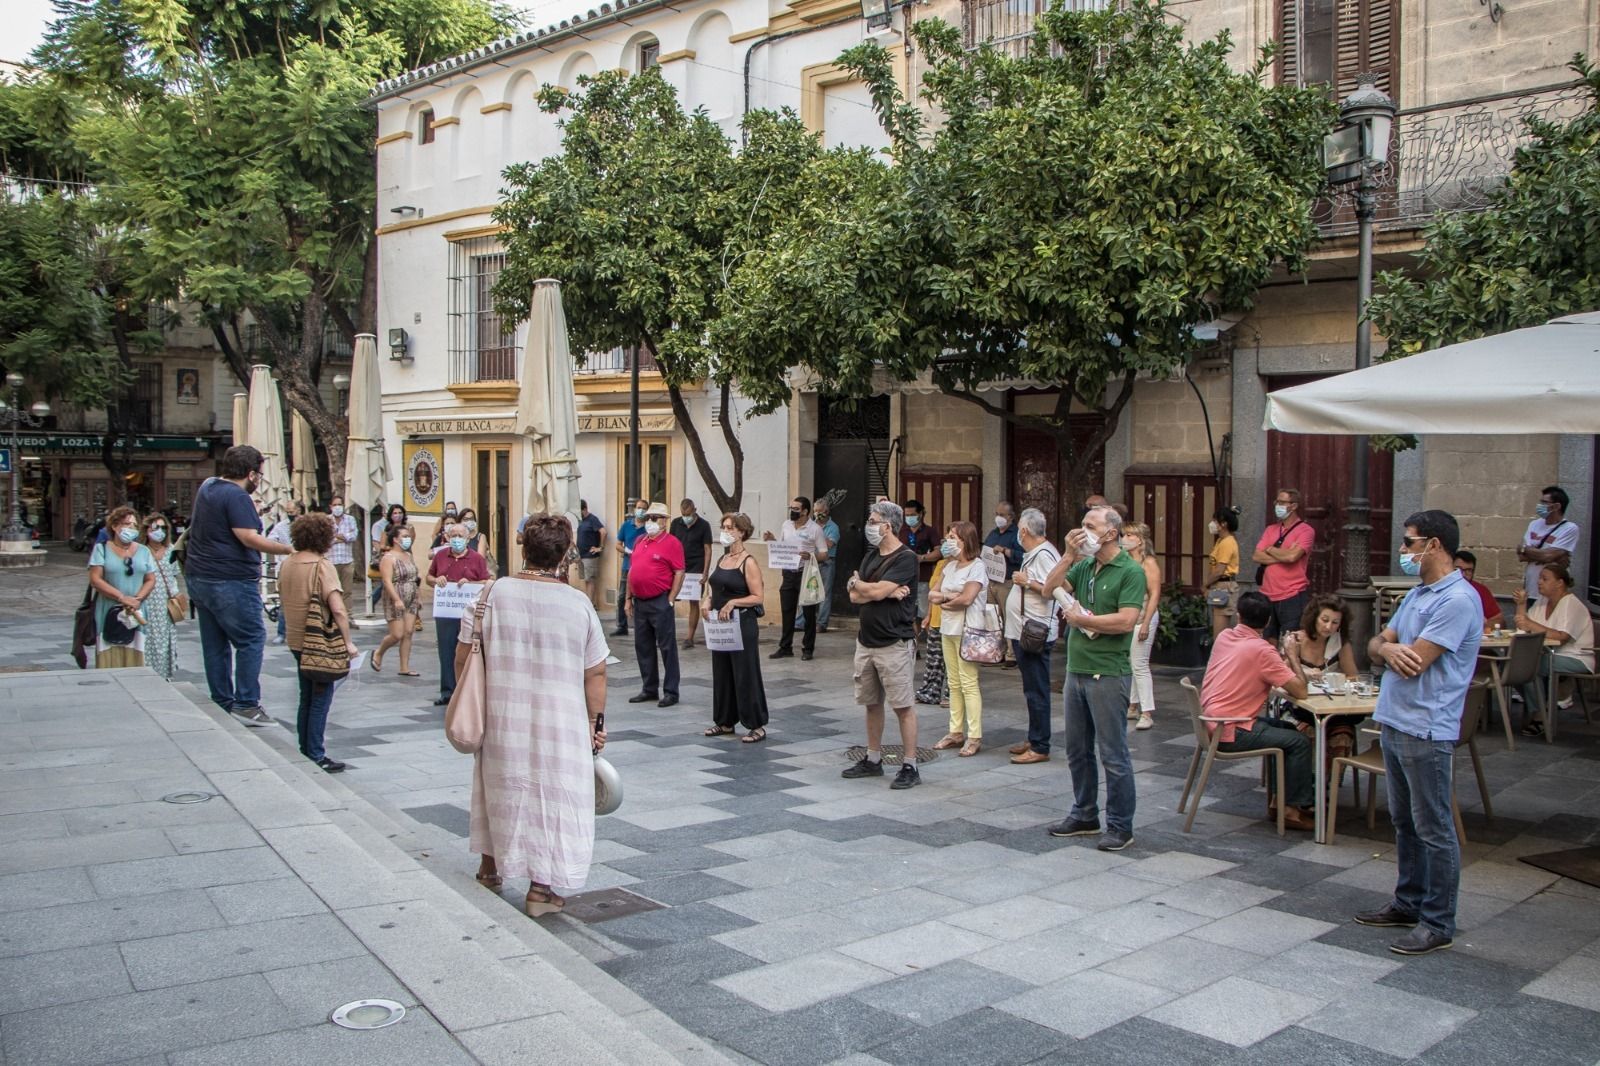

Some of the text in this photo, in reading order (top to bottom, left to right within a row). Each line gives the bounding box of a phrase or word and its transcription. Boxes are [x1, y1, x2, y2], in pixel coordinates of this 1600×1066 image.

[415, 422, 426, 433] LA
[429, 421, 453, 432] CRUZ
[456, 420, 492, 431] BLANCA
[62, 438, 91, 447] LOZA
[408, 450, 439, 481] LA AUSTRIACA
